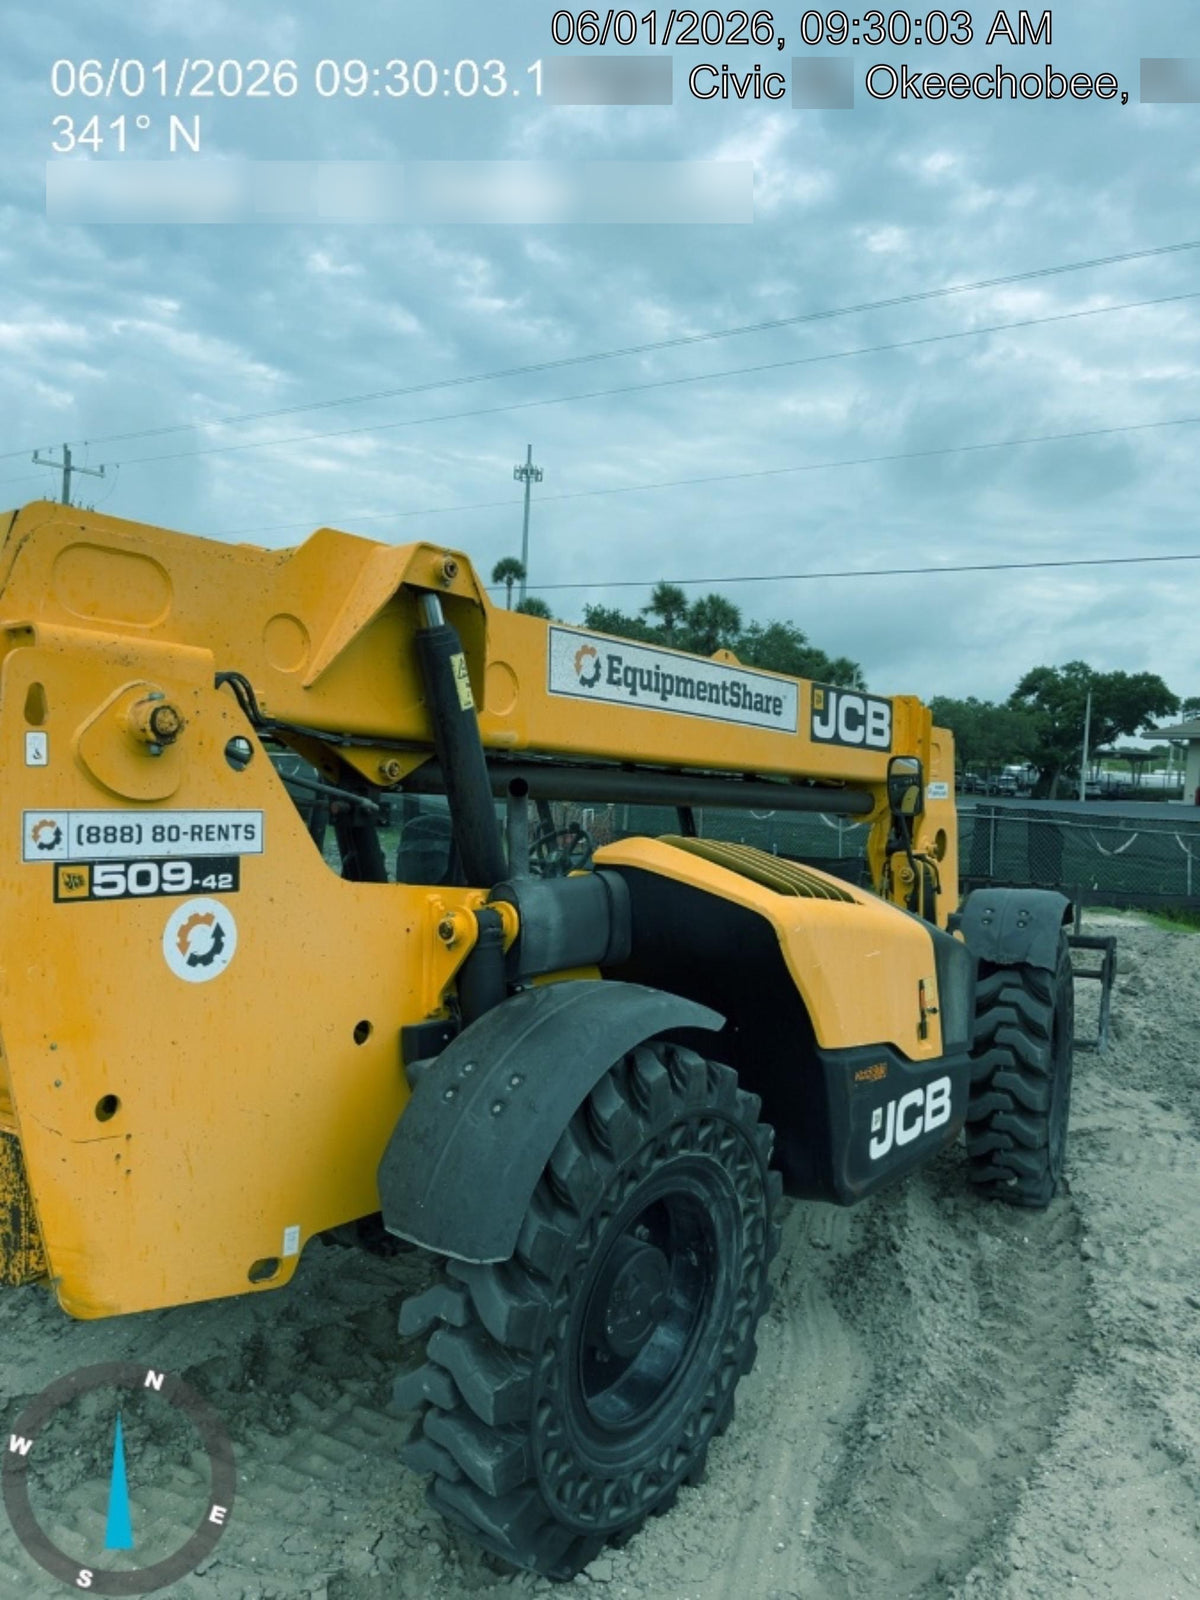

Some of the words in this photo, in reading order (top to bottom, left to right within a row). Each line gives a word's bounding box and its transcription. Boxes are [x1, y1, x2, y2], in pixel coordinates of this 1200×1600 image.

[605, 654, 783, 717] EquipmentShare
[812, 691, 891, 748] JCB
[76, 824, 143, 846] (888)
[152, 824, 256, 843] 80-RENTS
[869, 1076, 952, 1160] JCB
